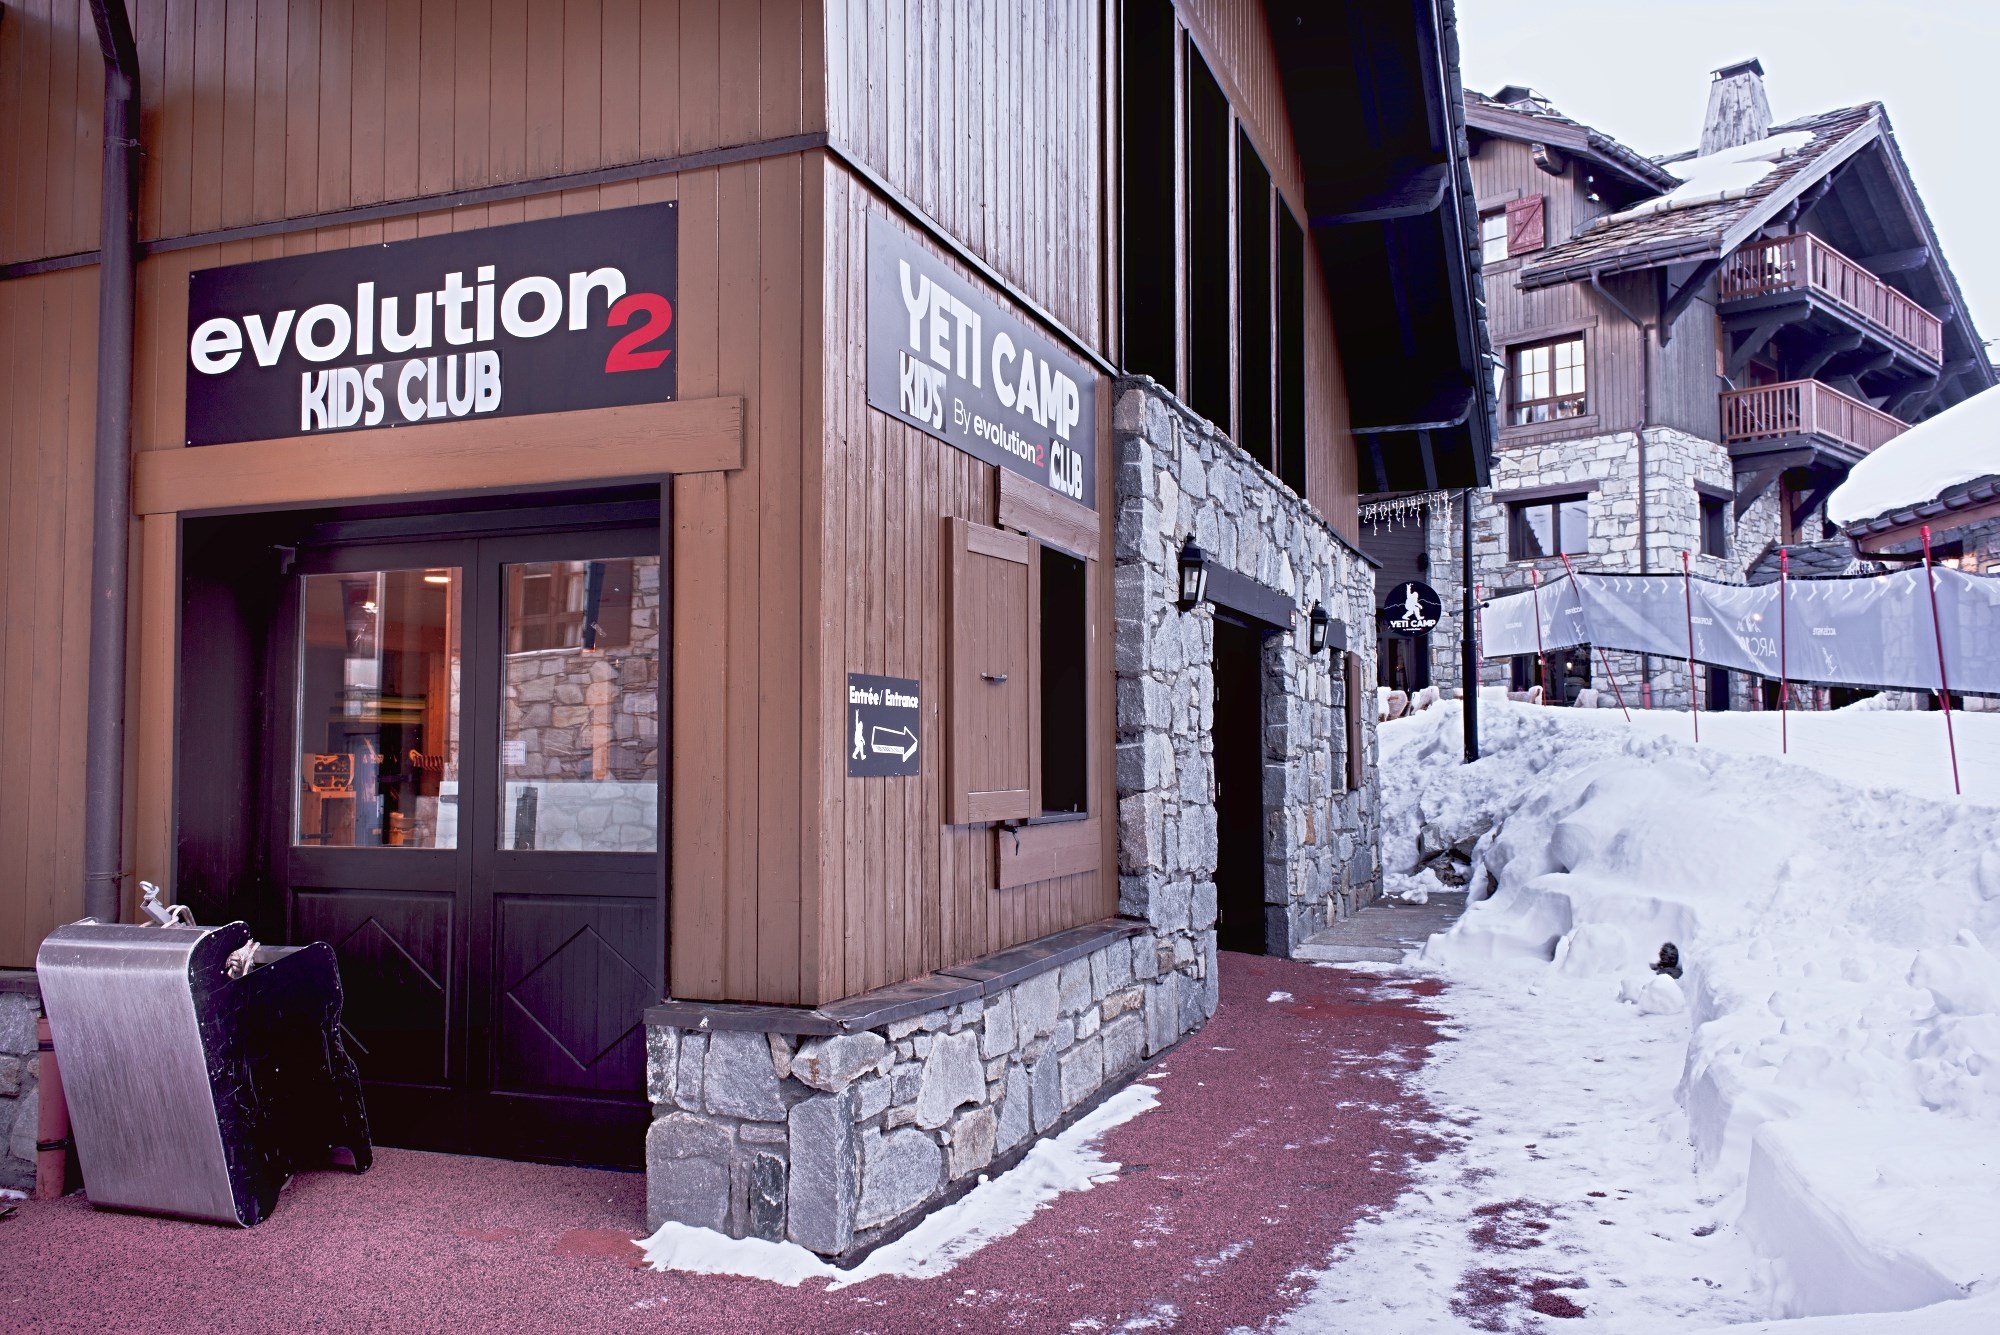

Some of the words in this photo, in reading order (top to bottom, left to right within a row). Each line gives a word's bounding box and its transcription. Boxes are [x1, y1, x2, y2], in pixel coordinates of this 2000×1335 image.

[900, 258, 981, 389] YETI
[992, 332, 1079, 441] CAMP
[302, 364, 384, 431] KIDS
[398, 350, 502, 422] CLUB
[900, 351, 946, 430] KIDS
[954, 398, 971, 434] By
[1050, 440, 1083, 500] CLUB
[1390, 620, 1409, 628] YETI
[1410, 619, 1436, 628] CAMP
[885, 688, 918, 708] Entrance
